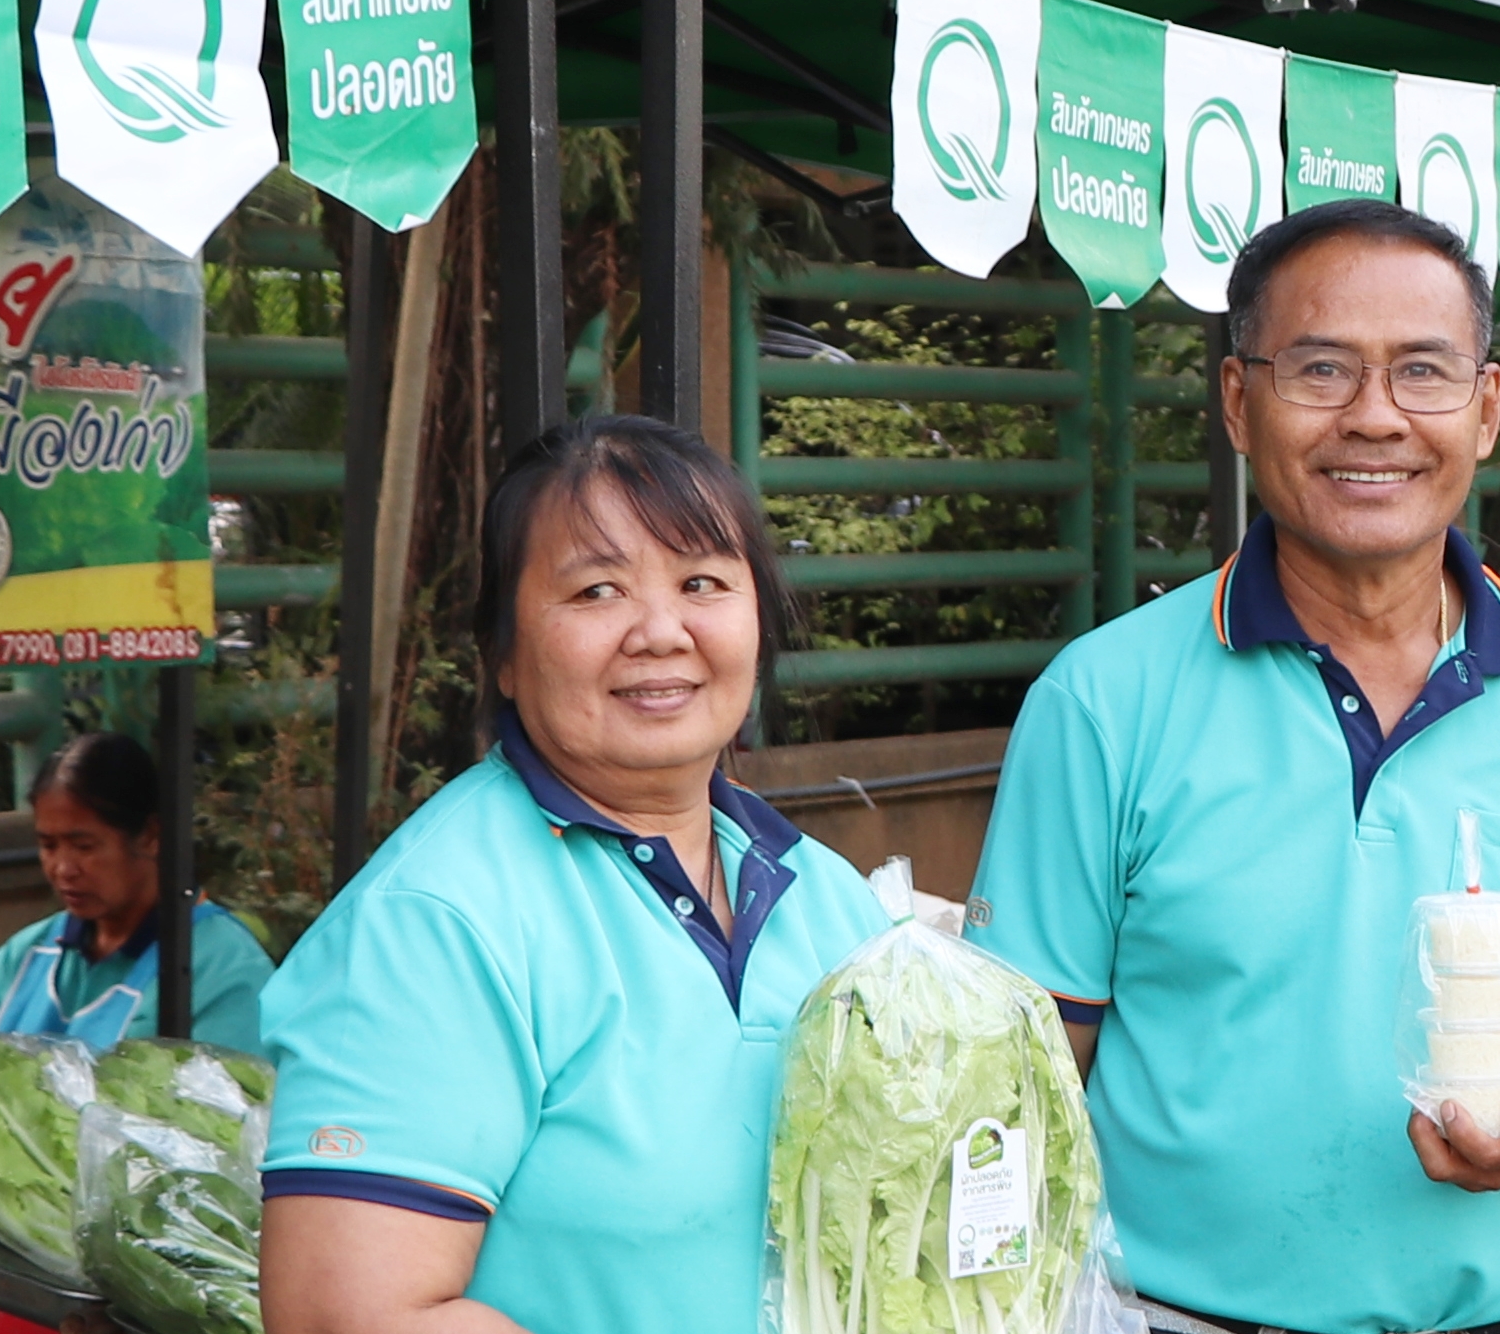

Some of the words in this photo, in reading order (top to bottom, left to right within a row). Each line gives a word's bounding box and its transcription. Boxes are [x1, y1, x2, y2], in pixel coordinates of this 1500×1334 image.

[310, 38, 455, 119] ปลอดภัย
[1051, 91, 1151, 154] สินค้าเกษตร
[1052, 155, 1148, 230] ปลอดภัย
[1298, 146, 1385, 195] สินค้าเกษตร
